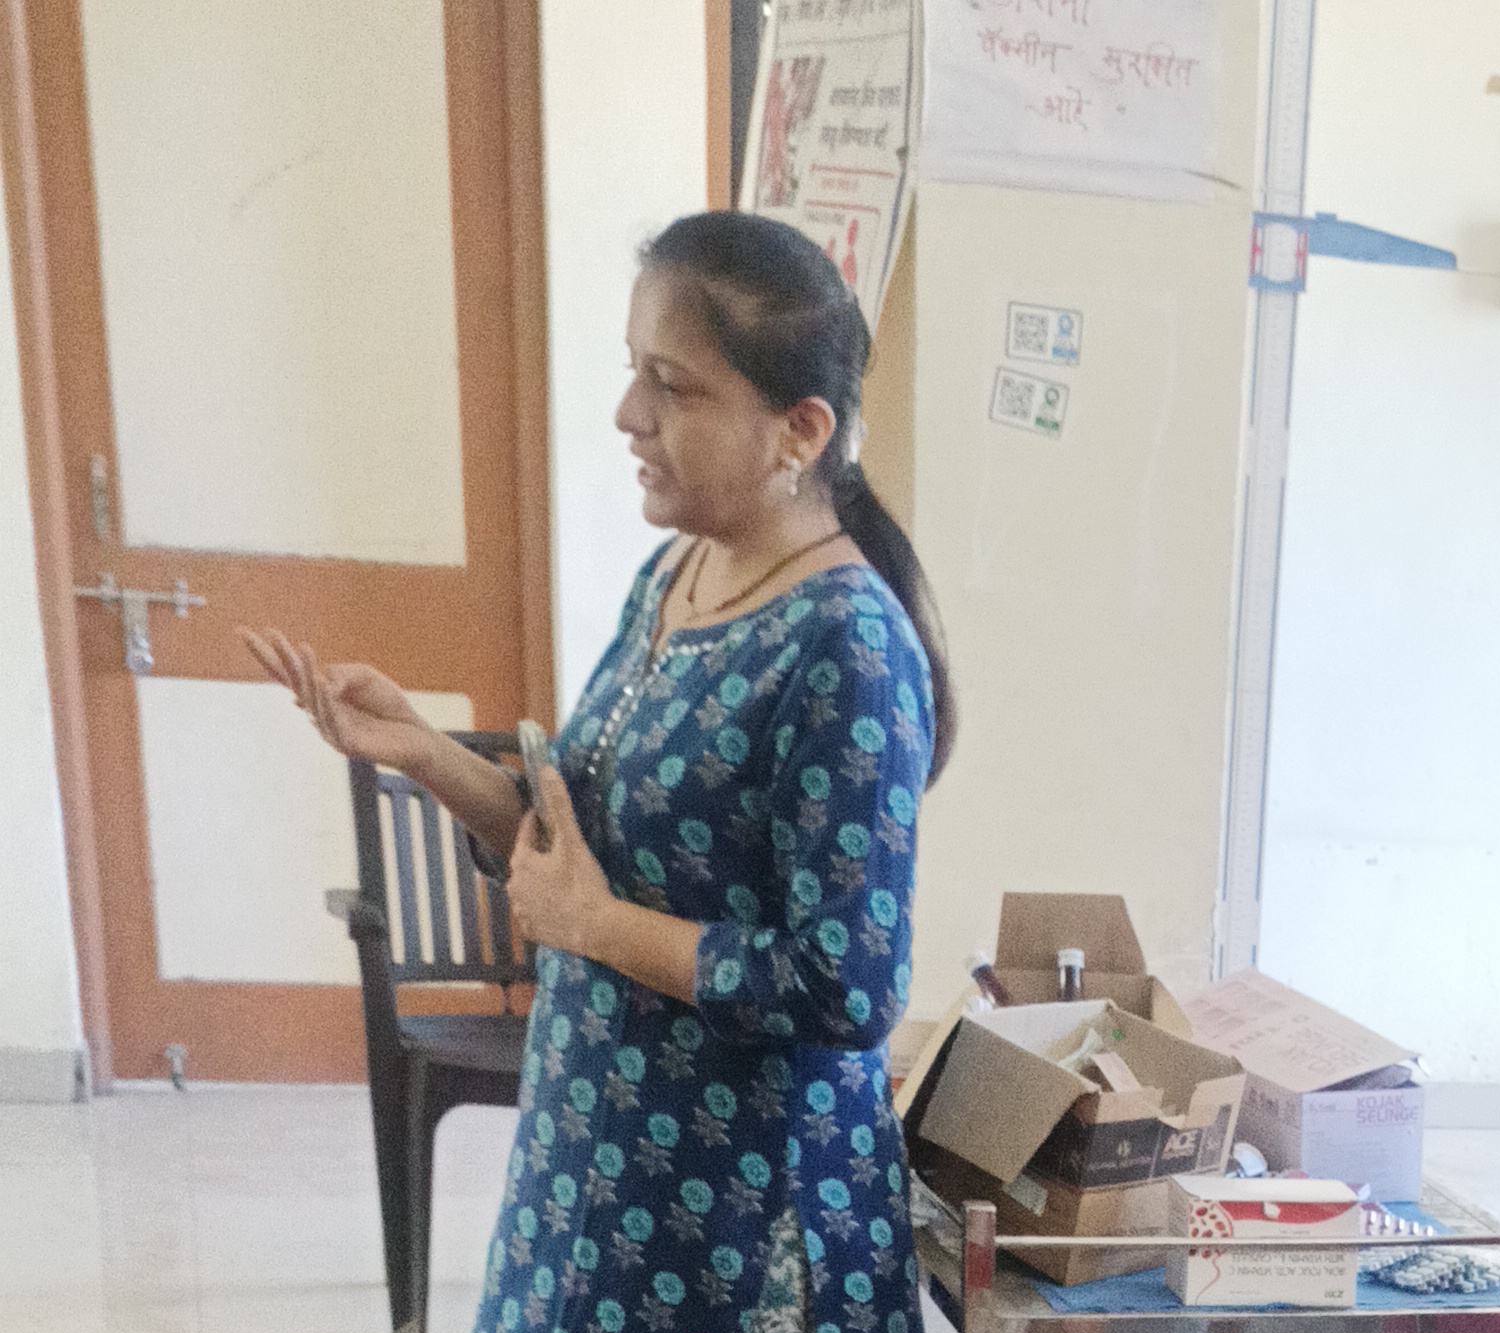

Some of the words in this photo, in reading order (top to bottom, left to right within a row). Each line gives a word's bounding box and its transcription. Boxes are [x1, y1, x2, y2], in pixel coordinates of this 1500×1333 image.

[1356, 1095, 1404, 1109] KOJAK
[1356, 1107, 1418, 1124] SELINGE
[1161, 1130, 1198, 1159] ACE
